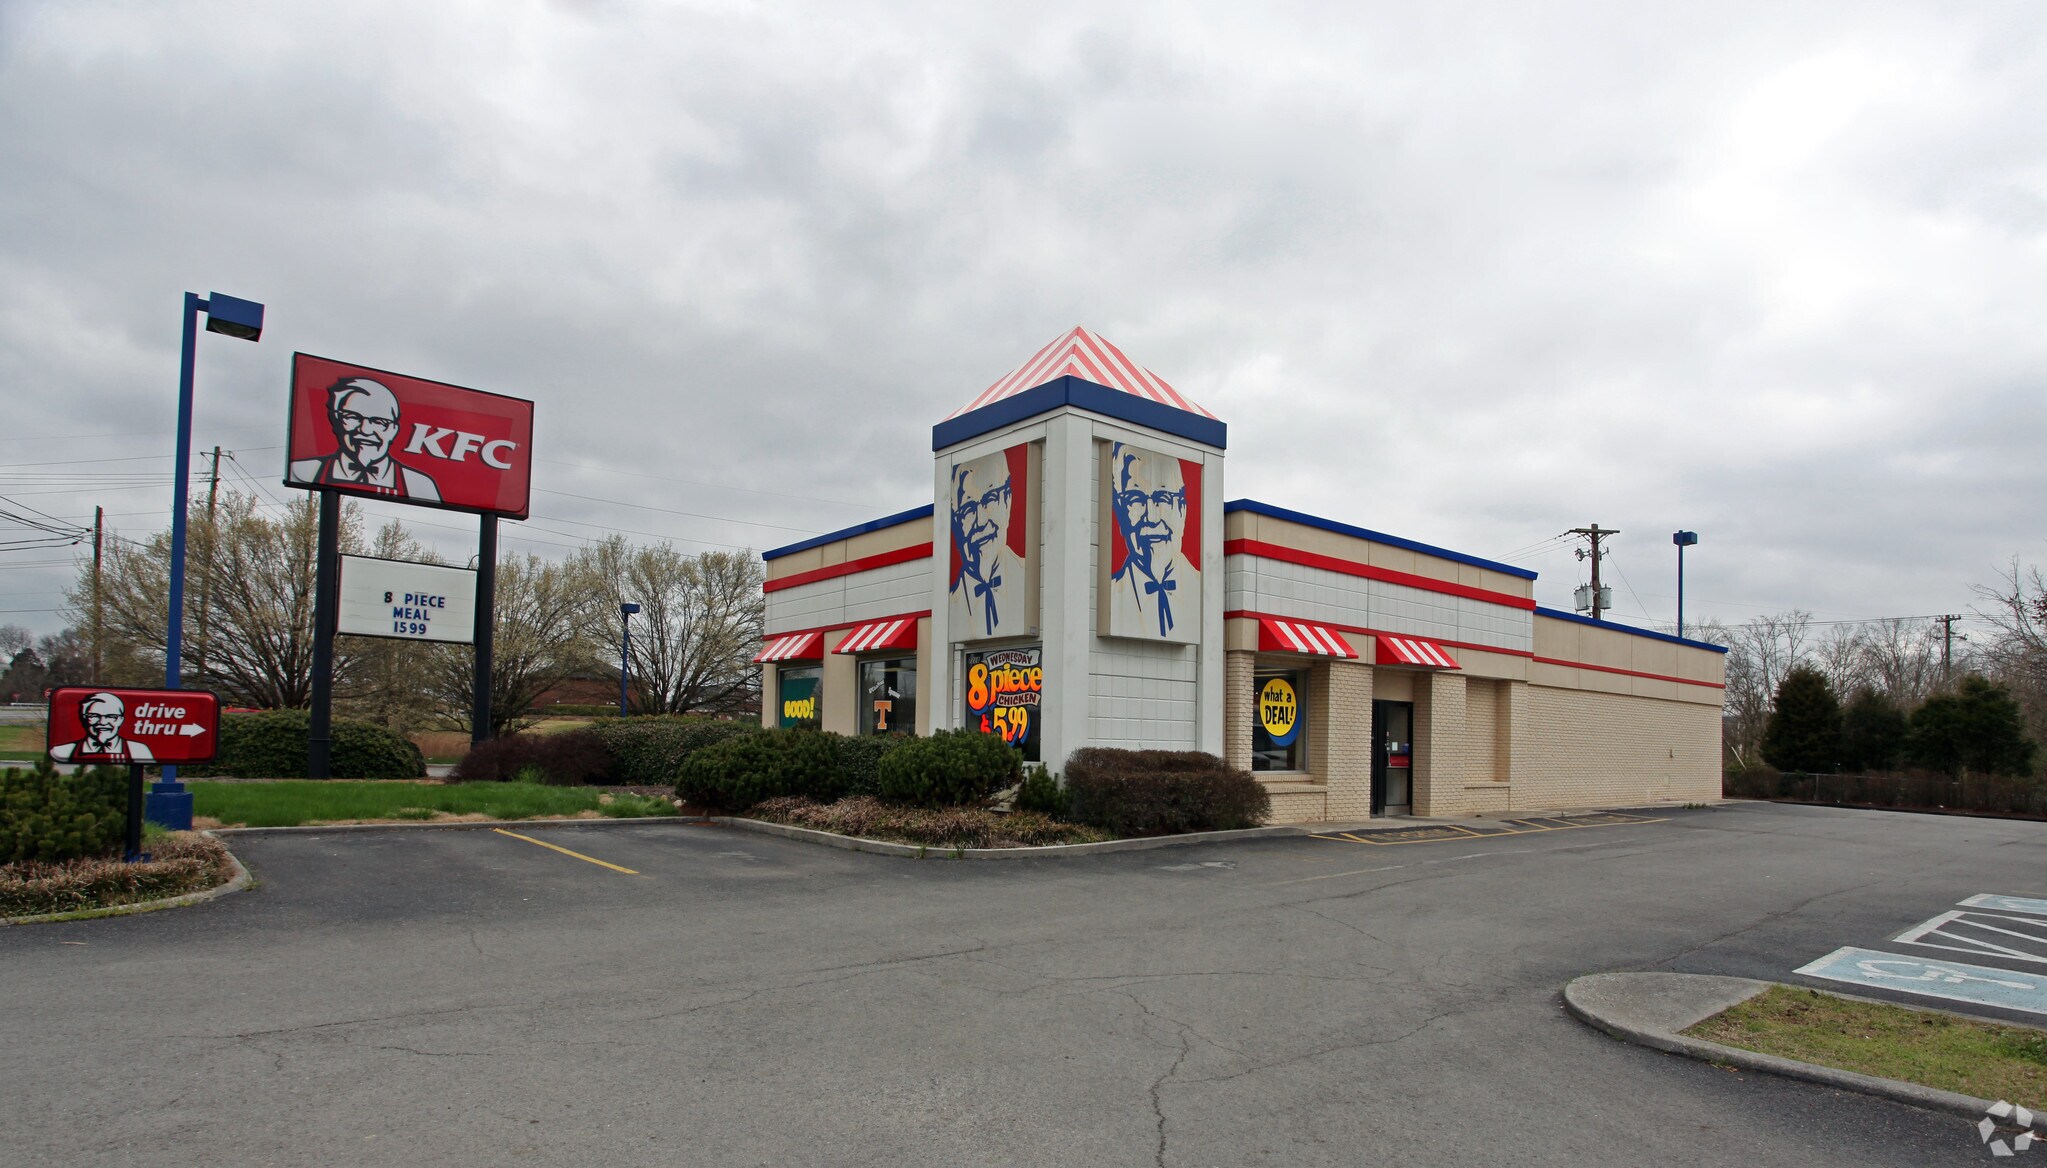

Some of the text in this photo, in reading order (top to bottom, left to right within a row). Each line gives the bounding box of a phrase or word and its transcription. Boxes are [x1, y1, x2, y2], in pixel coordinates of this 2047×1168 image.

[404, 422, 517, 470] KFC
[384, 591, 445, 608] 8 PIECE
[393, 606, 431, 621] MEAL
[394, 621, 427, 635] 1599
[989, 652, 1033, 666] WEDNESDAY
[968, 662, 1042, 710] 8 piece
[1264, 686, 1292, 703] what a
[998, 693, 1036, 706] CHICKEN
[134, 702, 186, 719] drive
[874, 700, 892, 730] T
[1265, 705, 1294, 725] DEAL!
[133, 720, 176, 736] thru
